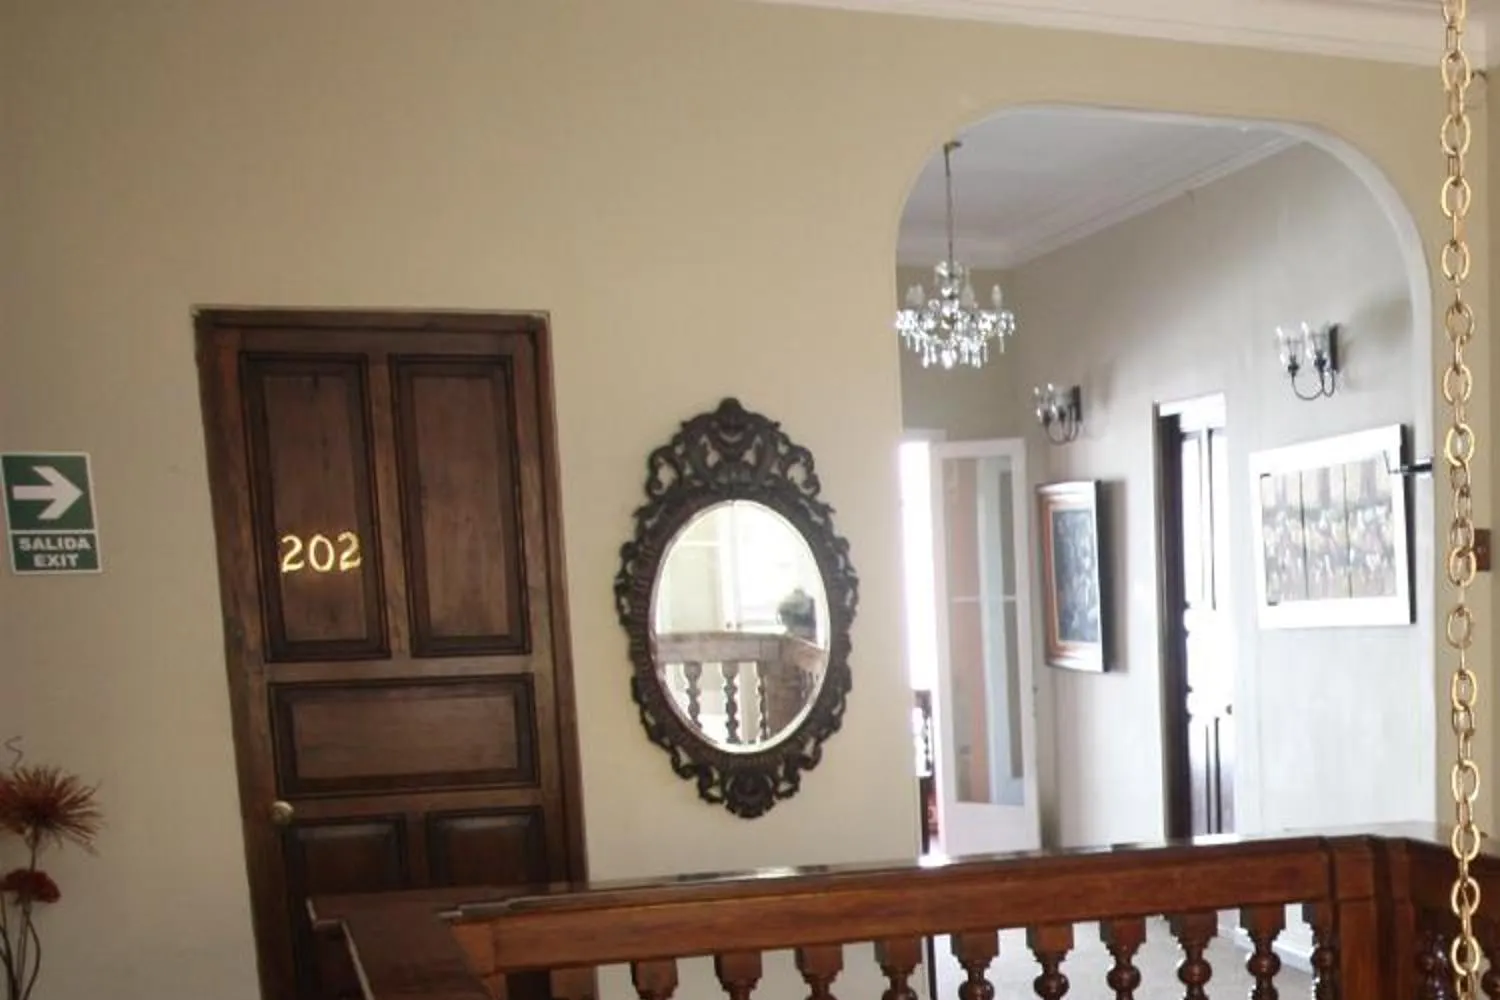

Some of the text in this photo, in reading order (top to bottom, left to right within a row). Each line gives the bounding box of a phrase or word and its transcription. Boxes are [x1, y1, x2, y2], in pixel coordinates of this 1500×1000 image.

[18, 536, 91, 551] SALIDA
[280, 531, 362, 573] 202
[33, 554, 79, 567] EXIT
